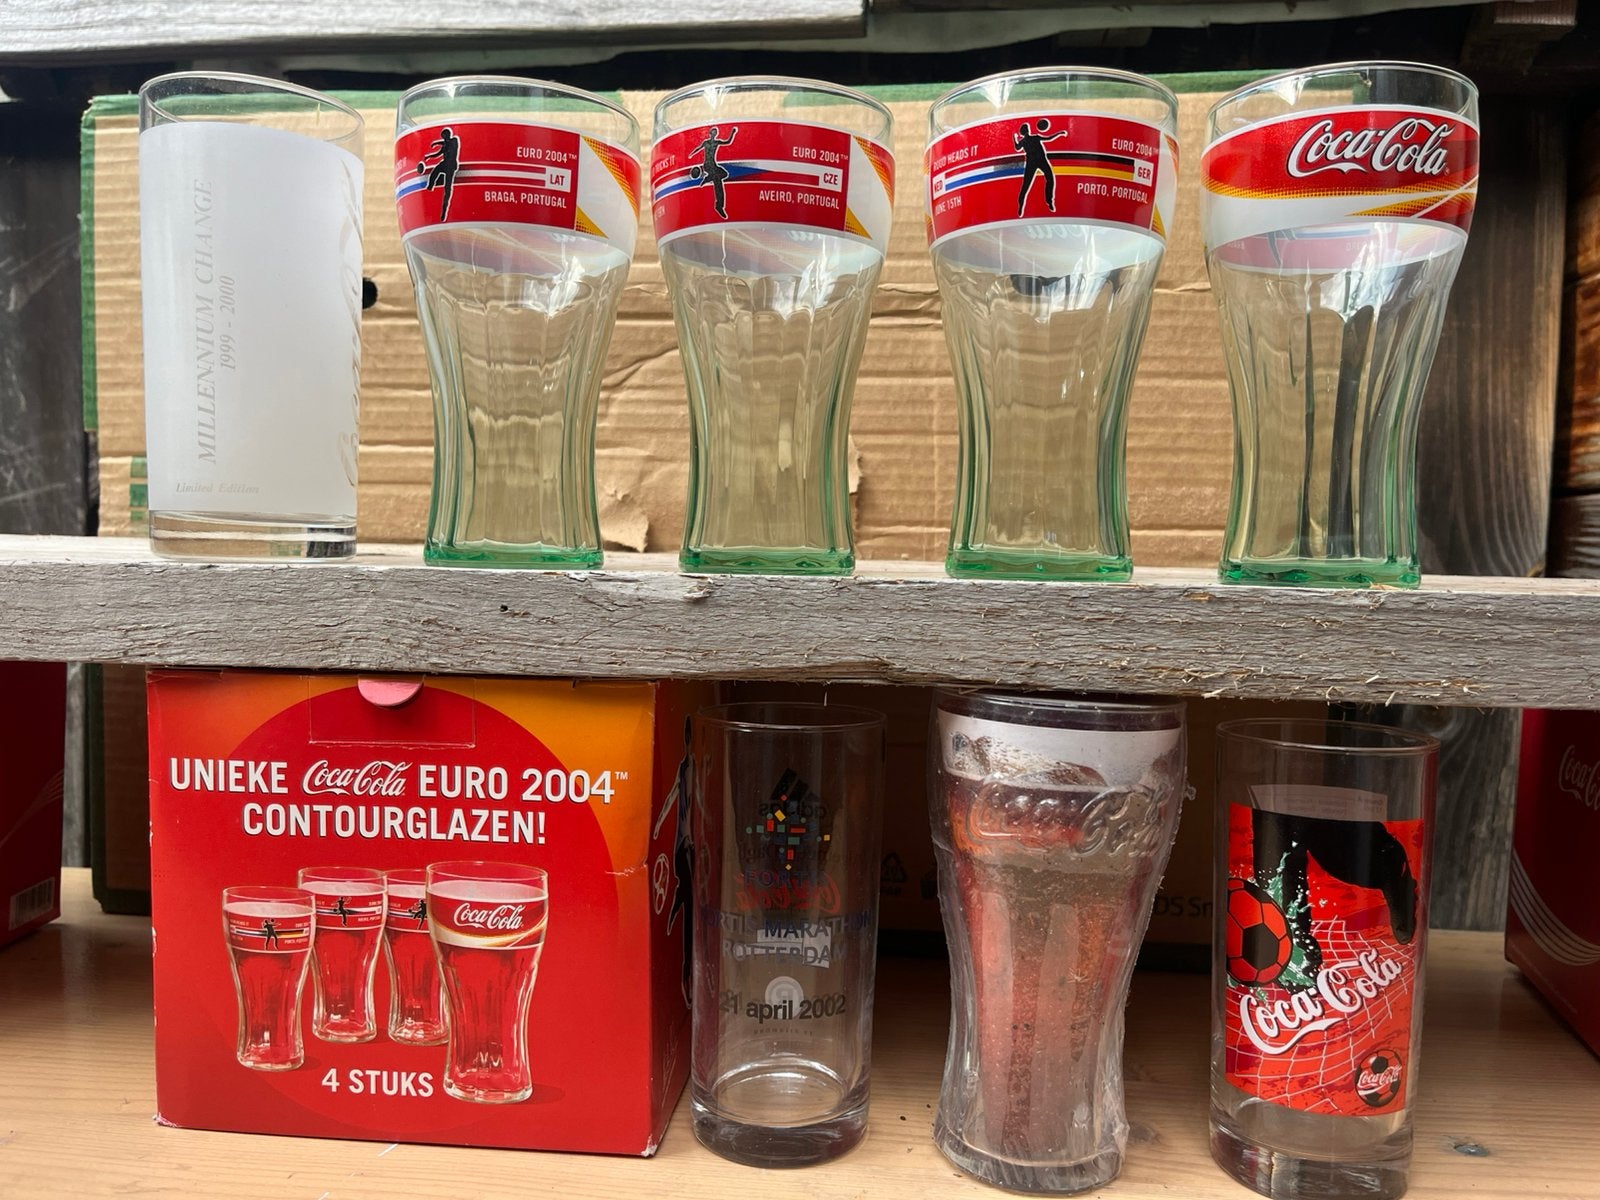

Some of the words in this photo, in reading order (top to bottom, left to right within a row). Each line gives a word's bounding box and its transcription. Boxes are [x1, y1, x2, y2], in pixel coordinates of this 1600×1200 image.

[517, 147, 543, 160] EURO
[792, 147, 817, 160] EURO
[947, 147, 969, 164] HEADS
[970, 144, 979, 157] IT
[1112, 138, 1134, 152] EURO
[1287, 118, 1456, 178] Coca-Cola
[550, 173, 565, 187] LAT
[823, 172, 838, 186] CZE
[1137, 166, 1152, 180] GER
[484, 191, 518, 204] BRAGA,
[520, 193, 567, 209] PORTUGAL
[759, 190, 795, 205] AVEIRO,
[798, 193, 840, 210] PORTUGAL
[947, 196, 962, 210] 15TH
[1077, 183, 1109, 197] PORTO,
[1112, 187, 1148, 205] PORTUGAL
[193, 179, 214, 285] CHANGE
[219, 275, 236, 315] 2000
[220, 335, 236, 370] 1999
[195, 294, 217, 465] MILLENNIUM
[175, 482, 214, 495] Limited
[218, 483, 260, 495] Edition
[169, 757, 289, 795] UNIEKE
[301, 759, 414, 798] Coca-Cola
[418, 764, 509, 801] EURO
[1559, 744, 1600, 812] Coca-C
[242, 802, 548, 845] CONTOURGLAZEN!
[453, 902, 525, 930] Coca-Cola
[764, 910, 872, 940] MARATHON
[722, 939, 848, 966] ROTTERDAM
[746, 999, 793, 1024] april
[799, 992, 847, 1020] 2002
[1239, 948, 1403, 1055] Coca-Cola
[321, 1069, 340, 1093] 4
[348, 1069, 434, 1098] STUKS
[1356, 1063, 1402, 1096] Coca-Cola
